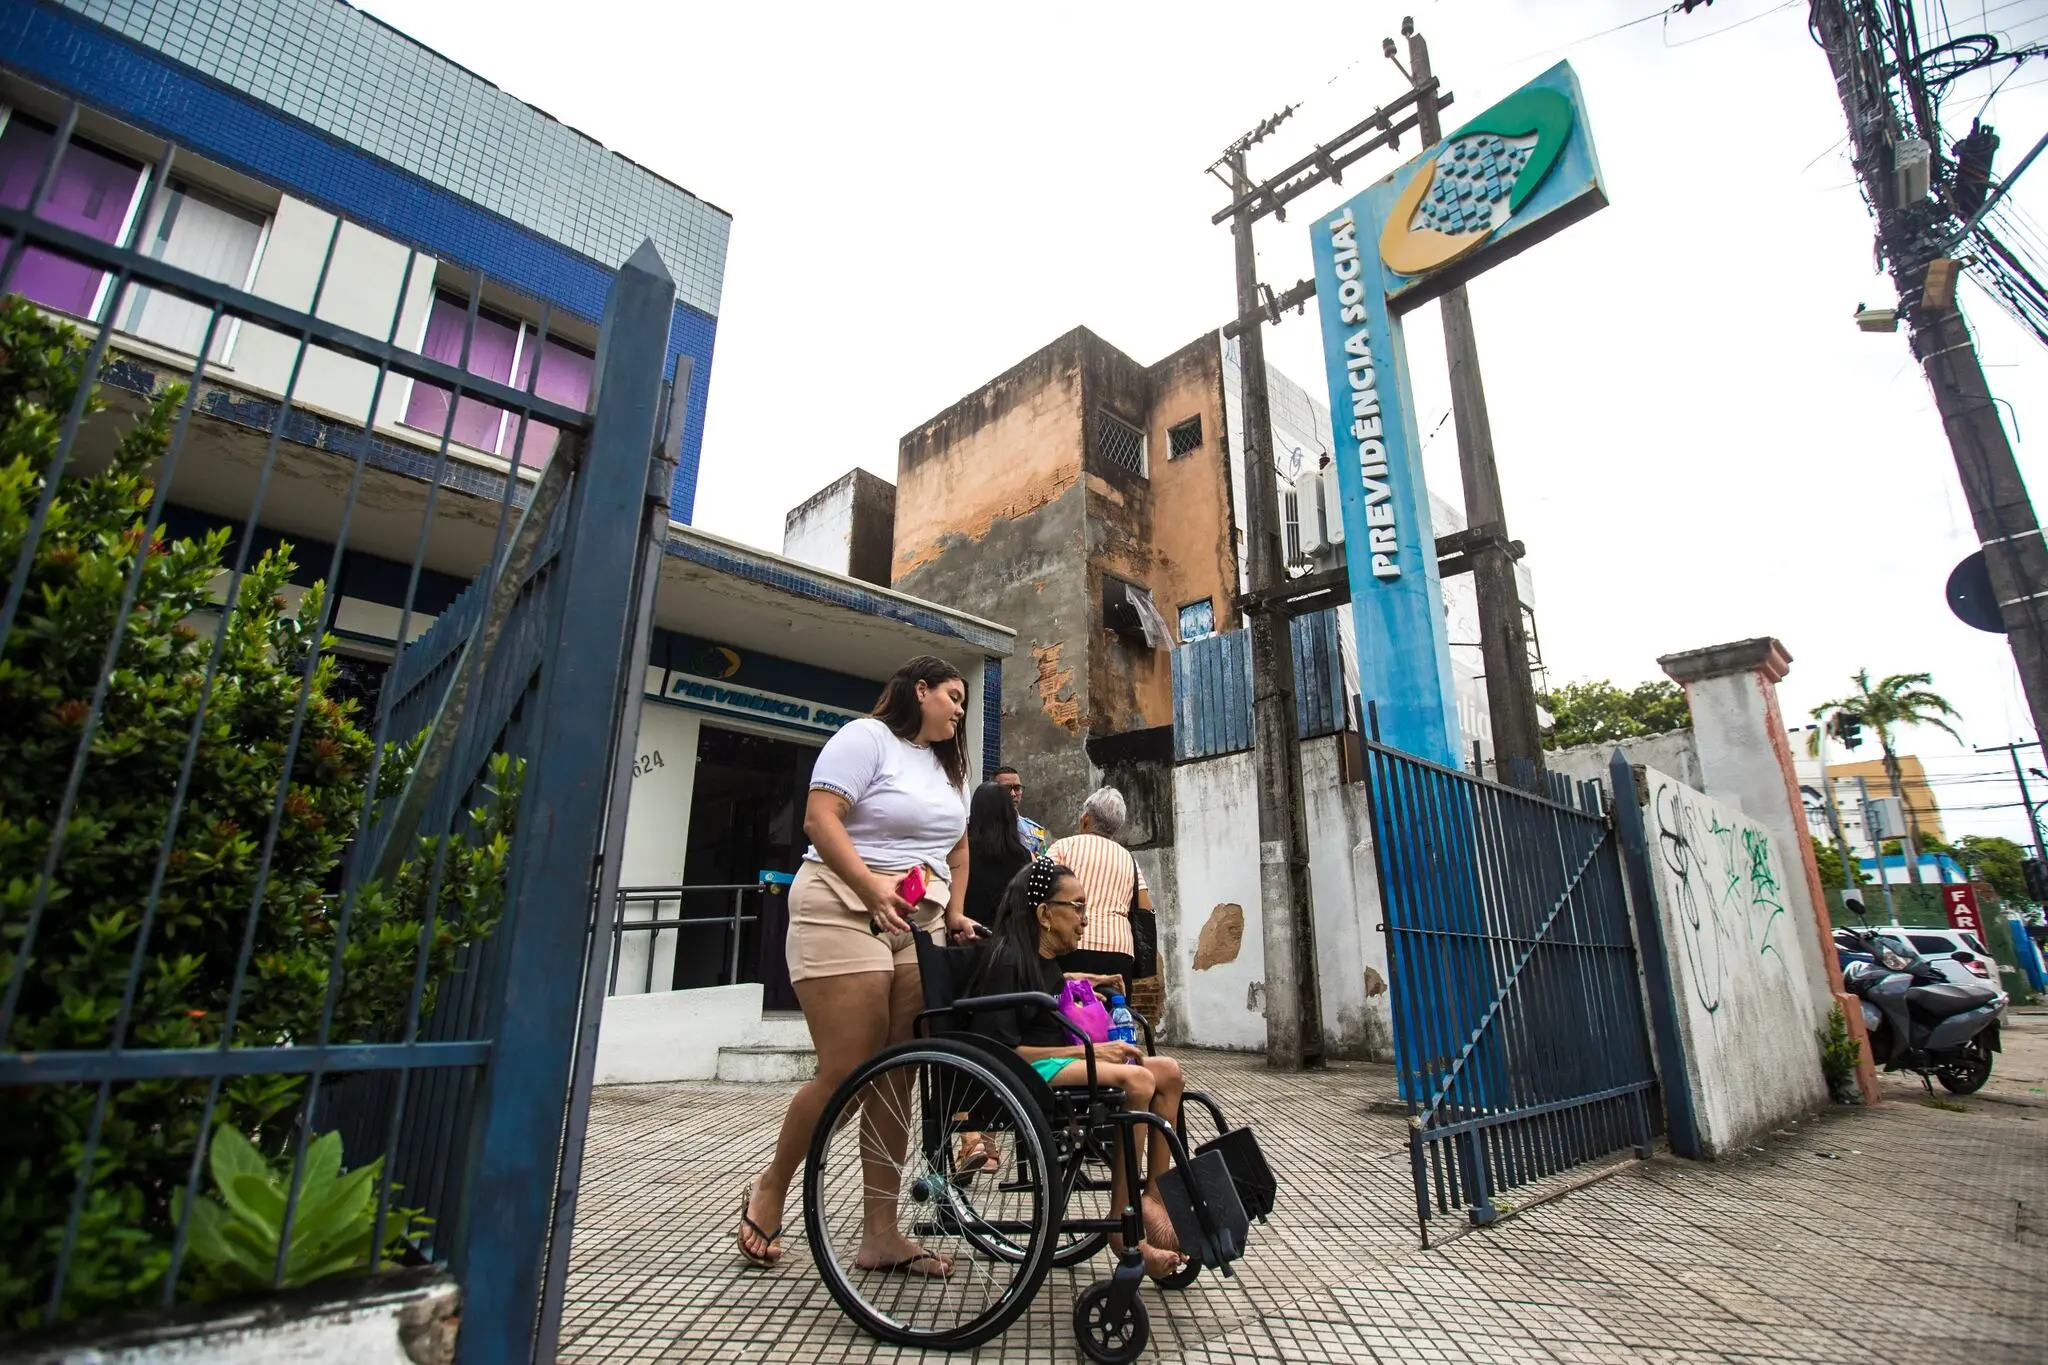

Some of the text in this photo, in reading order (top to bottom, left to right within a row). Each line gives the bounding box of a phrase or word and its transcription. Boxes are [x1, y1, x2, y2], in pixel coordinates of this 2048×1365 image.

[1329, 207, 1400, 578] PREVIDÊNCIA SOCIAL
[813, 709, 854, 727] SOC
[1950, 890, 1976, 928] FAR
